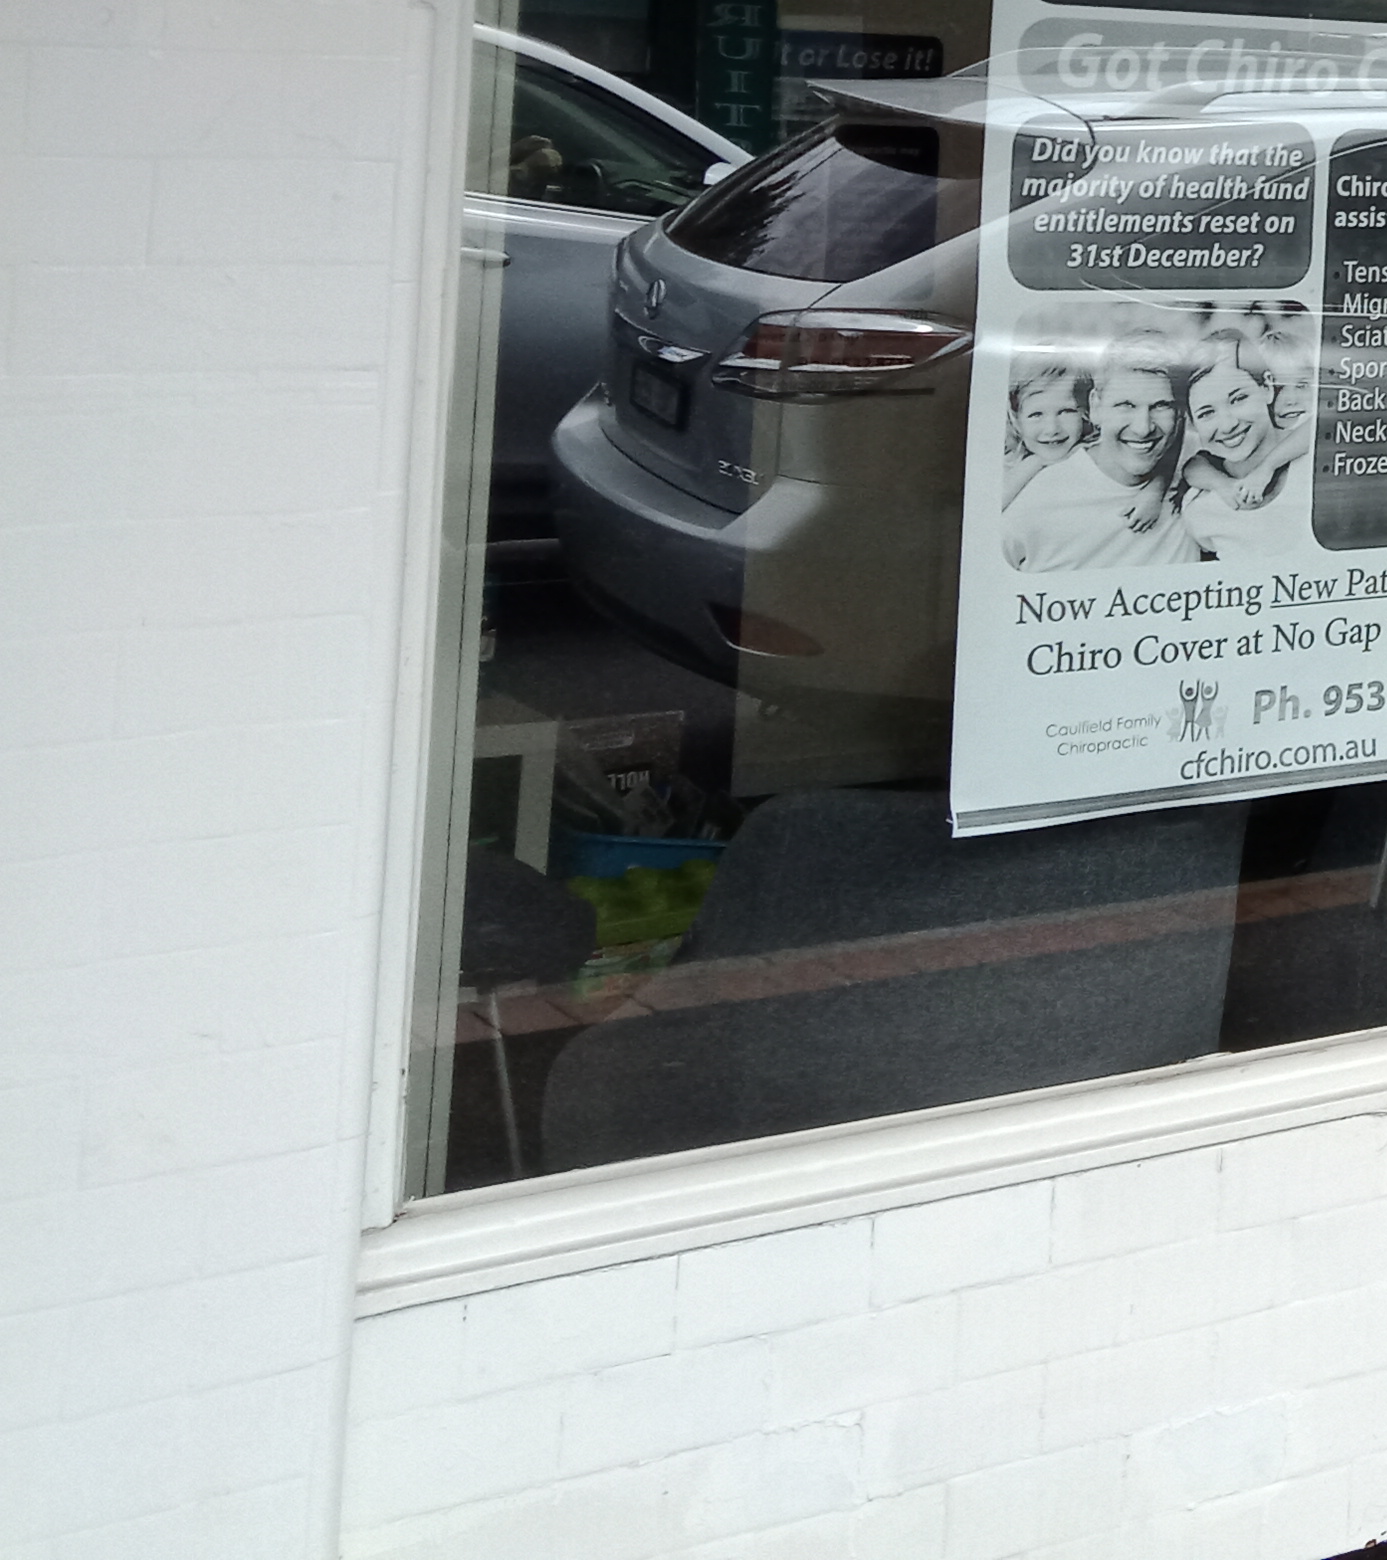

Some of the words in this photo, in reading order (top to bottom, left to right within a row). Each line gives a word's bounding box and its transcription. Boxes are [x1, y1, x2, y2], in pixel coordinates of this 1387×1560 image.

[800, 47, 829, 67] or
[836, 44, 898, 70] Lose
[904, 47, 935, 72] it!
[1058, 32, 1167, 92] Got
[1185, 39, 1341, 100] Chiro
[1032, 137, 1077, 164] Did
[1083, 144, 1130, 176] you
[1135, 139, 1204, 166] know
[1210, 143, 1260, 167] that
[1266, 144, 1303, 168] the
[1021, 175, 1133, 207] majority
[1139, 176, 1167, 200] of
[1169, 176, 1248, 199] health
[1252, 176, 1309, 202] fund
[1033, 208, 1193, 234] entitlements
[1198, 213, 1259, 234] reset
[1264, 216, 1295, 234] on
[1067, 244, 1121, 269] 31st
[1126, 244, 1263, 271] December?
[1337, 389, 1386, 414] Back
[1336, 420, 1385, 445] Neck
[1015, 592, 1096, 625] Now
[1105, 578, 1263, 620] Accepting
[1270, 573, 1339, 606] New
[1026, 637, 1122, 676] Chiro
[1133, 629, 1224, 667] Cover
[1237, 625, 1263, 657] at
[1271, 622, 1315, 654] No
[1323, 616, 1381, 656] Gap
[1252, 685, 1311, 725] Ph.
[1045, 718, 1112, 738] Caulfield
[1116, 711, 1162, 732] Family
[1057, 734, 1147, 757] Chiropractic
[1179, 737, 1377, 781] cfchiro.com.au
